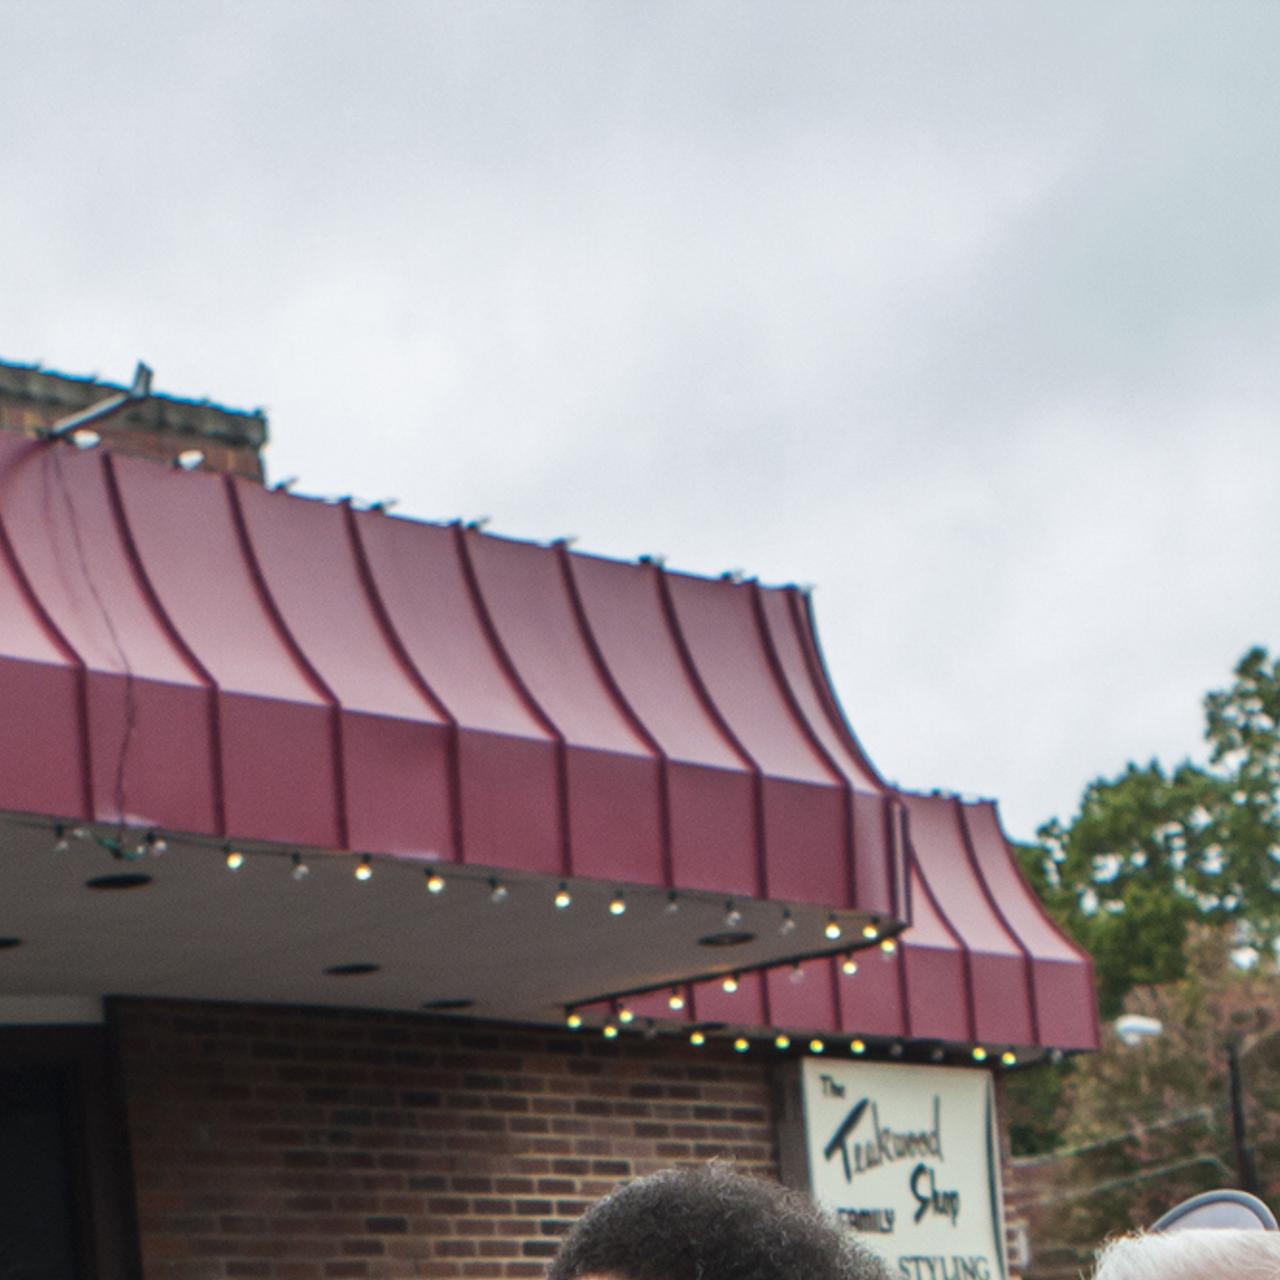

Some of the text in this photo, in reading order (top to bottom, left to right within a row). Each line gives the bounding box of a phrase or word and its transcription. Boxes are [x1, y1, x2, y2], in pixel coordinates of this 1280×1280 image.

[819, 1073, 845, 1098] The
[824, 1093, 944, 1184] Teakwood
[910, 1162, 960, 1229] Shop
